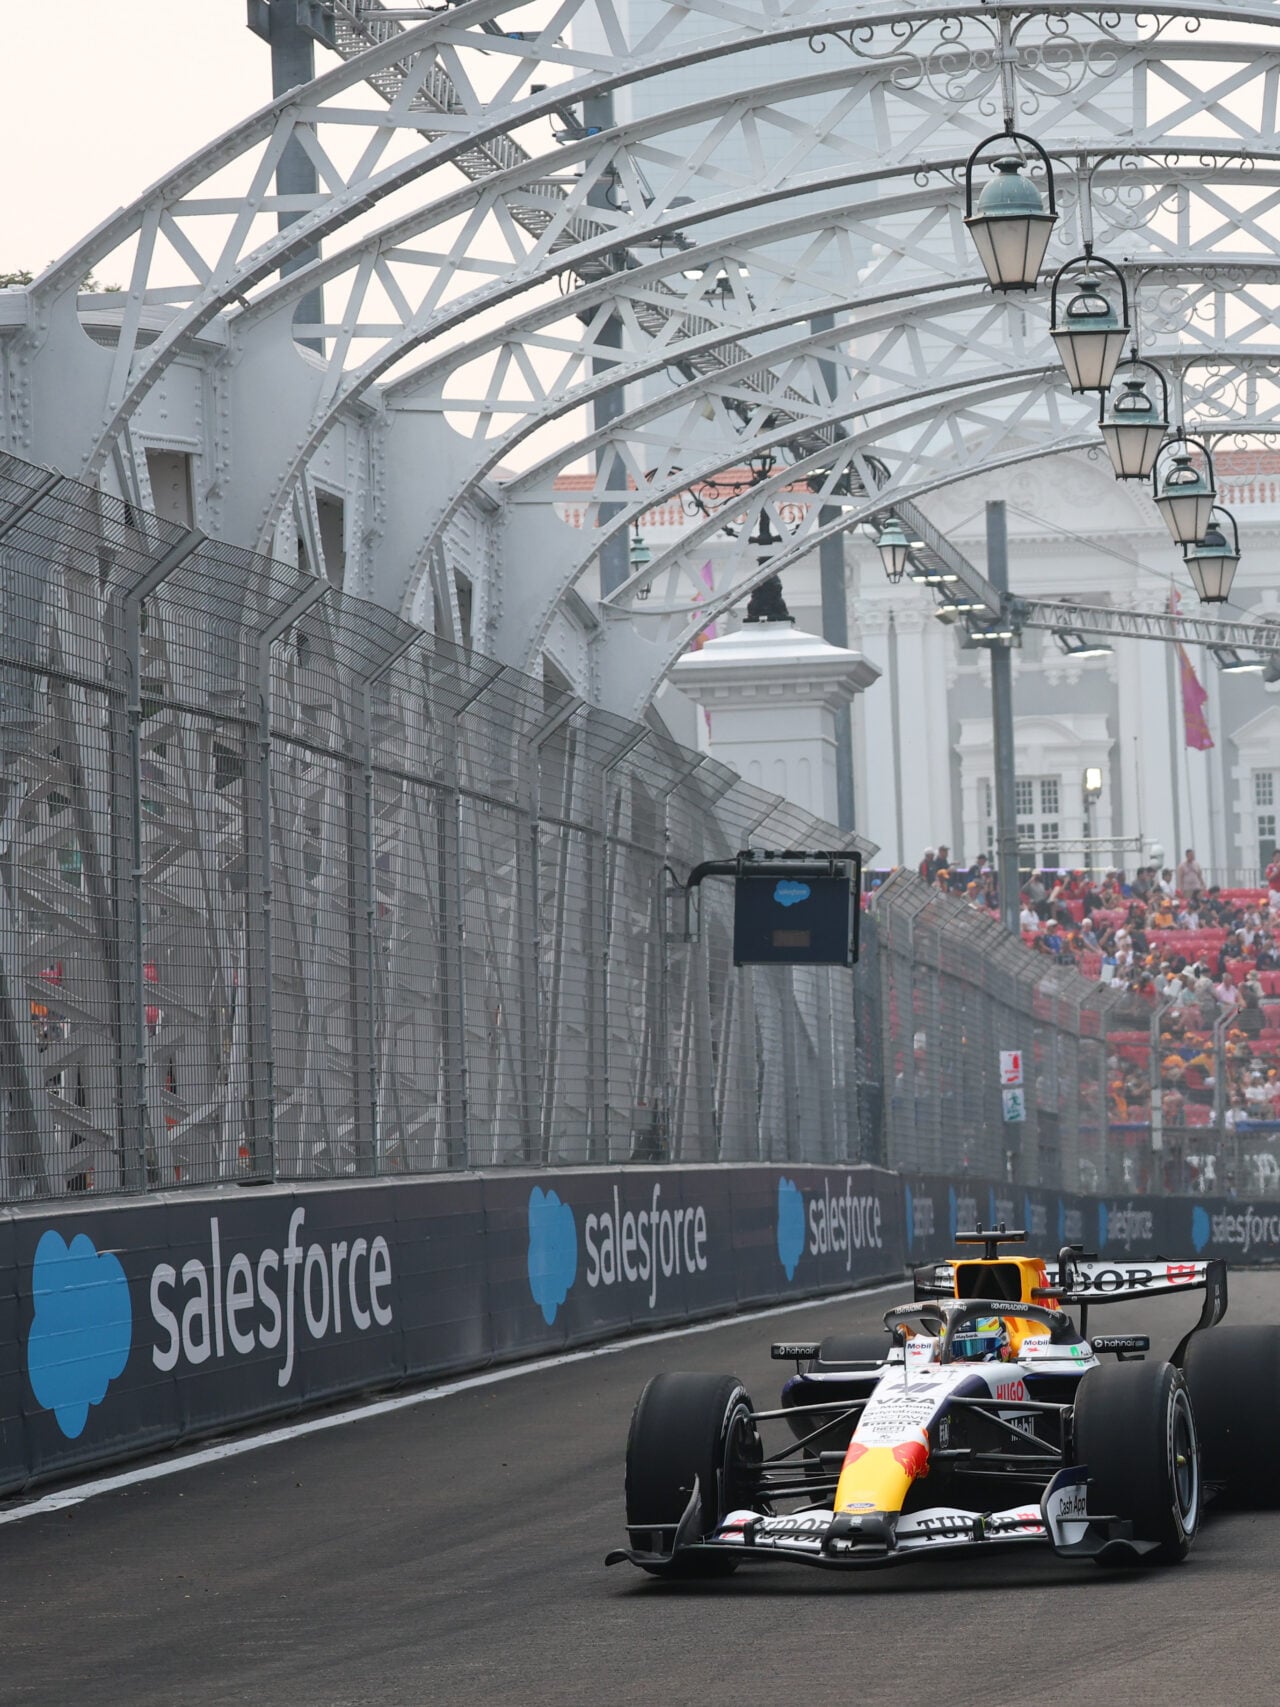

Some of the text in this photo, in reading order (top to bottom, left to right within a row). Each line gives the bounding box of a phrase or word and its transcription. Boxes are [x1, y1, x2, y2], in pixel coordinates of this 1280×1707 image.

[809, 1176, 882, 1271] salesforce
[586, 1183, 707, 1308] salesforce
[150, 1207, 392, 1387] salesforce
[786, 1346, 815, 1355] hahnair
[1104, 1339, 1136, 1348] hahnair
[996, 1380, 1024, 1402] HUGO
[1060, 1496, 1086, 1516] Cash App
[916, 1515, 1022, 1542] TUDR
